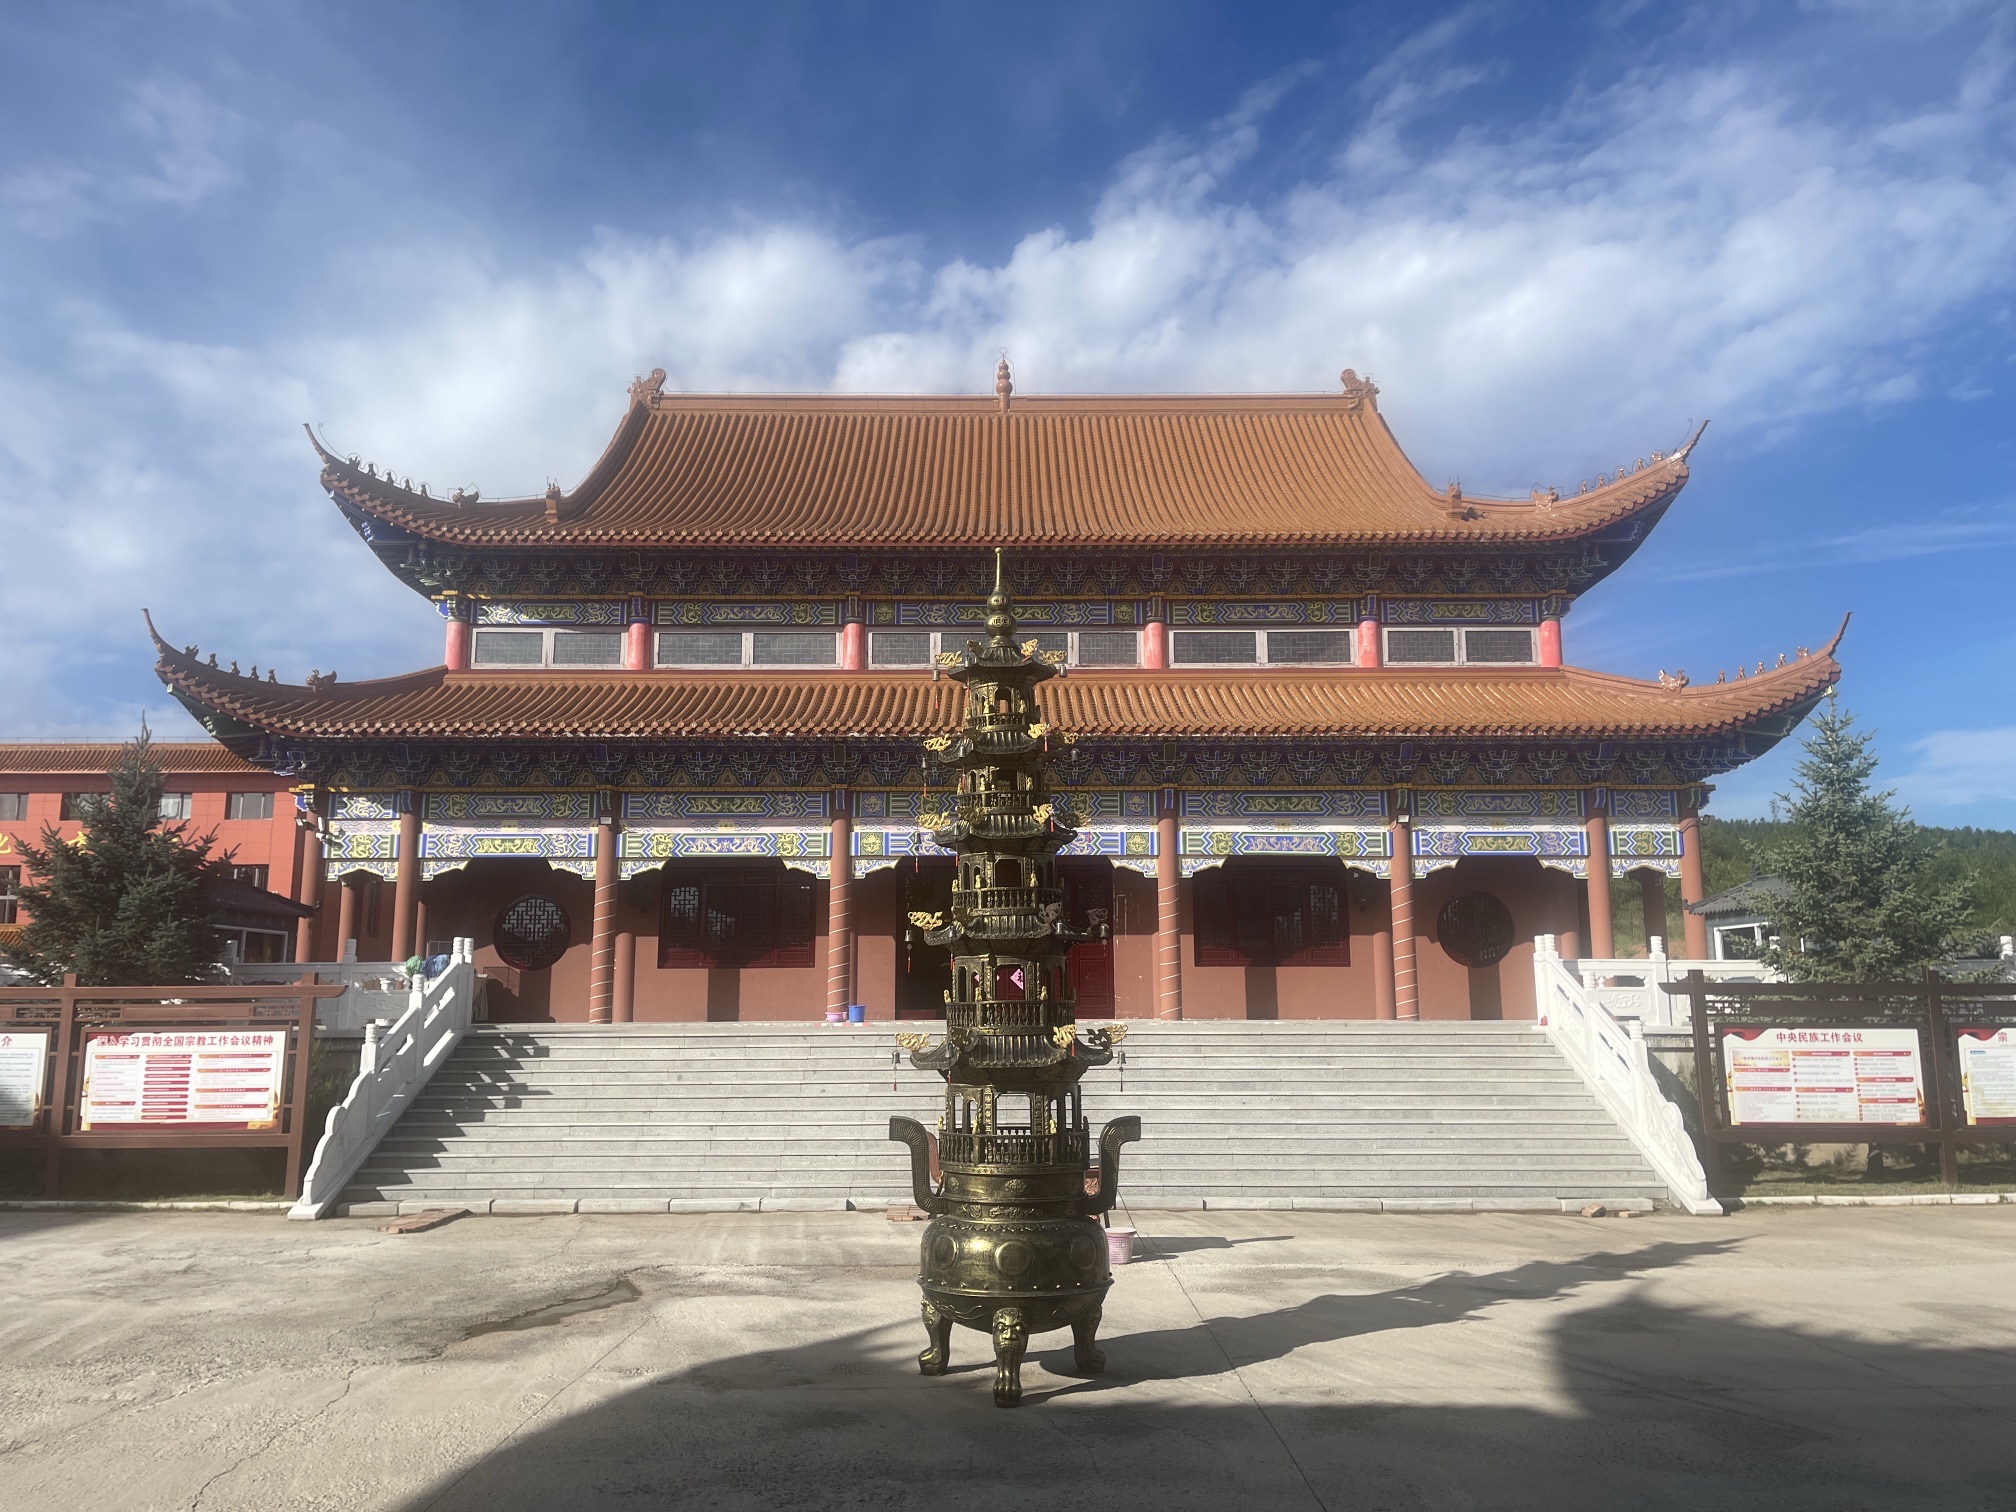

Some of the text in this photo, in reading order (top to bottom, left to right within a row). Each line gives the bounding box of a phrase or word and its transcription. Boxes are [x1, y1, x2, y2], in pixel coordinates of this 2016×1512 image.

[1, 1035, 12, 1047] 介
[96, 1035, 274, 1047] 深入学习贯彻全国宗教工作会议精神
[1776, 1031, 1863, 1043] 中央民族工作会议
